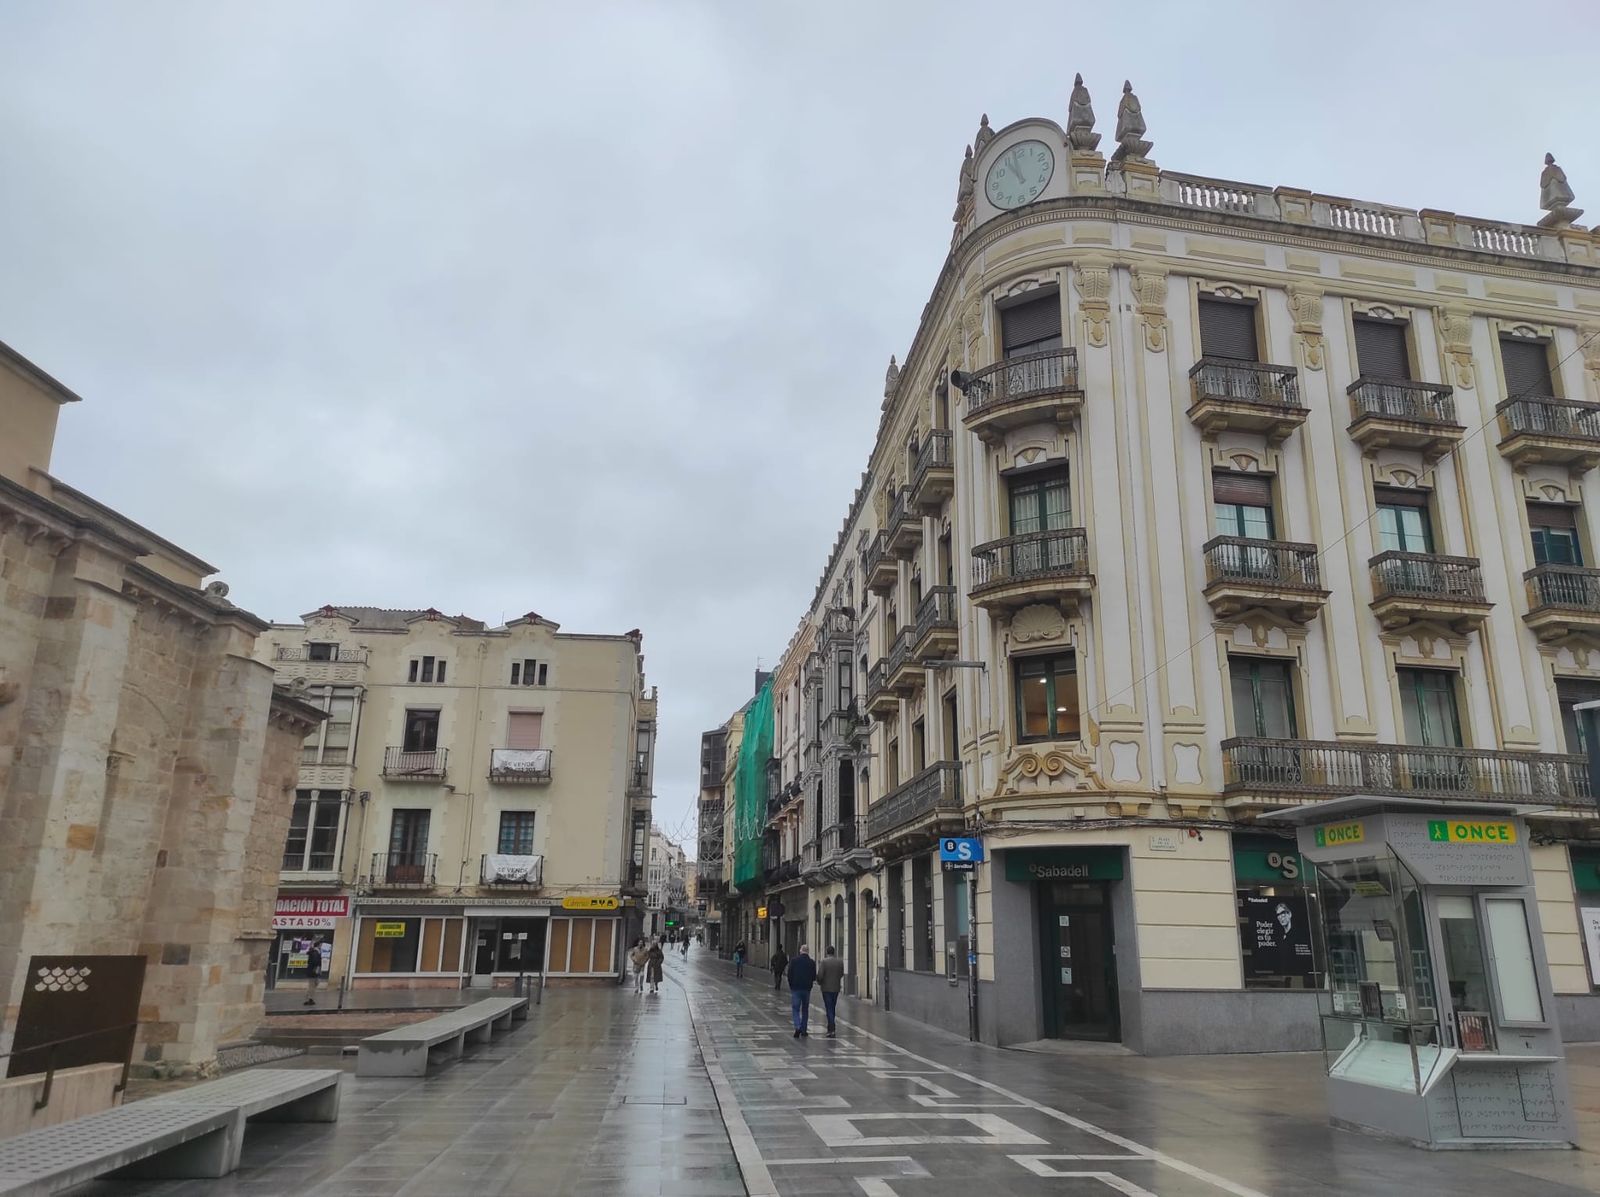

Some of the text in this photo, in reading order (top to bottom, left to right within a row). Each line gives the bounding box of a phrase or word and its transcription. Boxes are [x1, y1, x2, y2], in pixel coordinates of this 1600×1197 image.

[996, 168, 1005, 179] 10
[1030, 186, 1038, 196] 5
[1329, 825, 1360, 842] ONCE
[1455, 825, 1508, 840] ONCE
[1036, 864, 1089, 878] Sabadell
[316, 899, 345, 912] TOTAL
[307, 918, 332, 926] 50%
